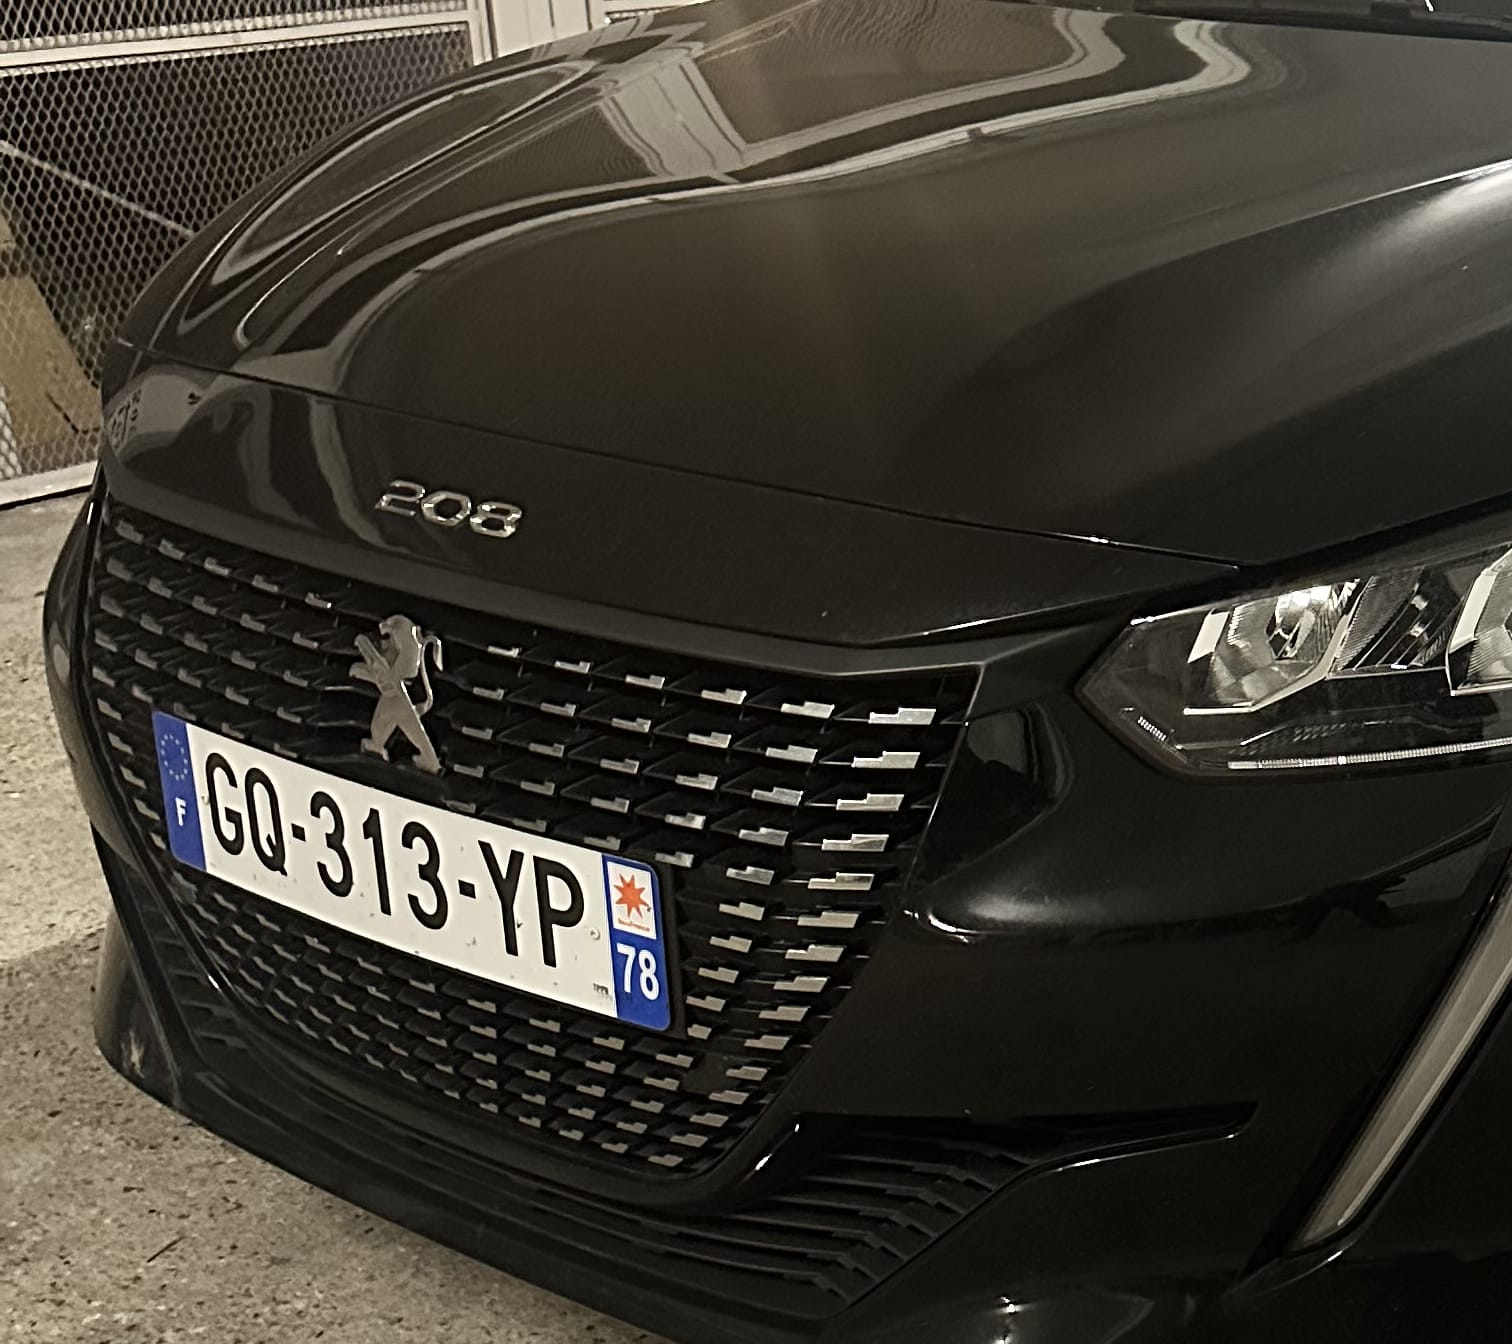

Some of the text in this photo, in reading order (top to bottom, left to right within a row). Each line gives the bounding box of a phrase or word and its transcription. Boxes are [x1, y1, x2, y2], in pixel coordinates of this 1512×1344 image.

[375, 479, 523, 538] 208
[175, 796, 187, 827] F
[205, 752, 585, 968] GQ-313-YP
[616, 942, 660, 1001] 78
